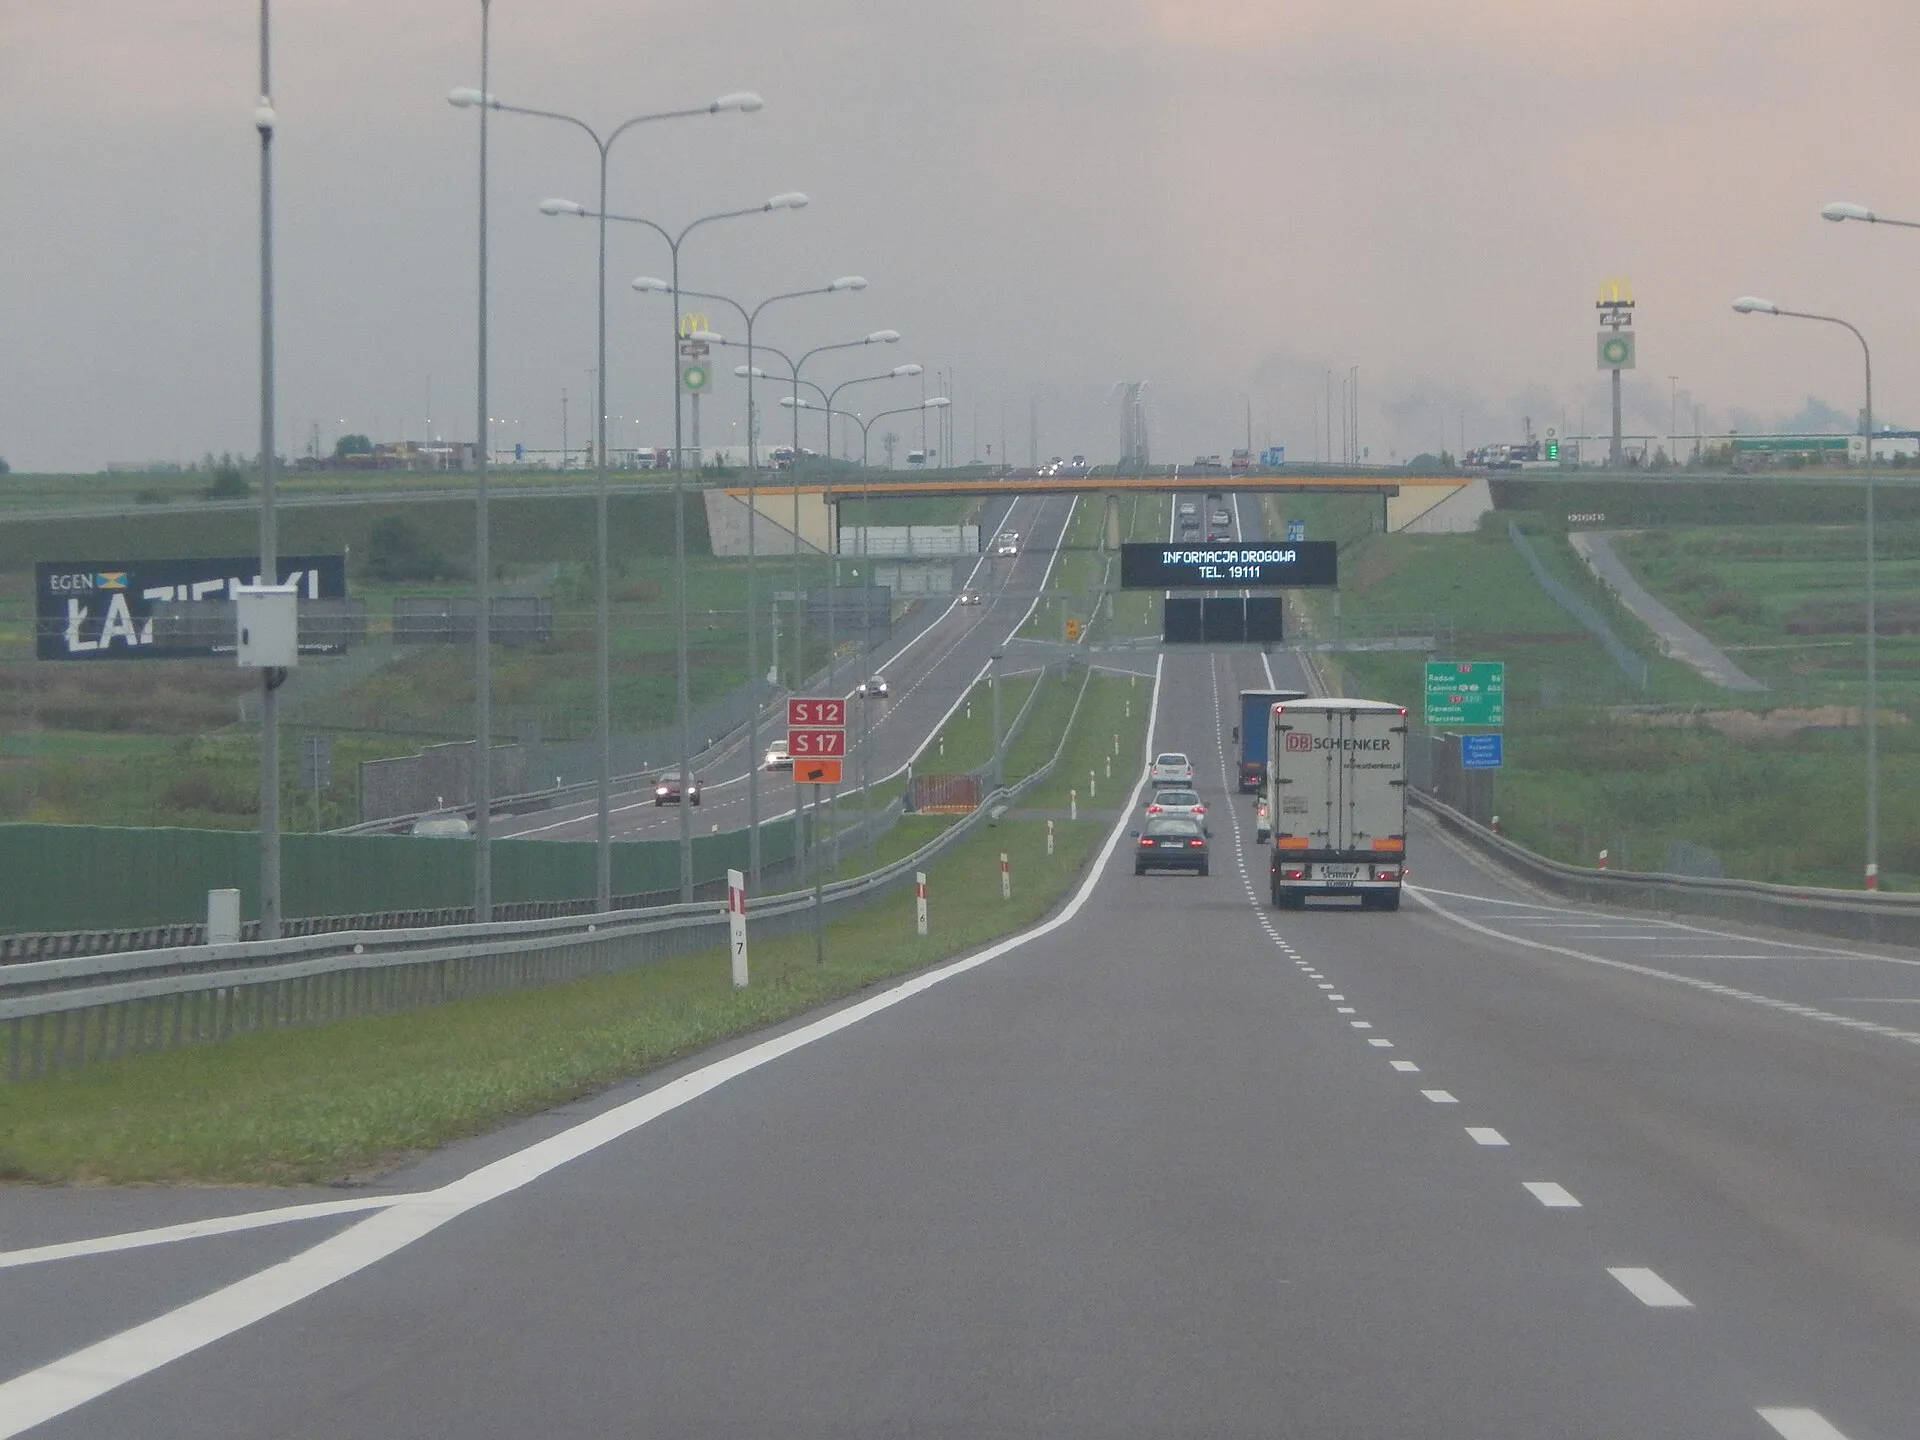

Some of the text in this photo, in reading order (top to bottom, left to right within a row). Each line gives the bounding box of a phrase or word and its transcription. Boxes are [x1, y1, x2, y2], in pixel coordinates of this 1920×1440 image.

[1163, 551, 1296, 563] INFORMACJA DROGOWA
[1199, 566, 1260, 578] TEL. 19111
[50, 574, 94, 590] EGEN
[796, 703, 838, 720] S 12
[797, 734, 837, 752] S 17
[1288, 735, 1390, 751] DB SCHENKER
[736, 943, 743, 954] 7
